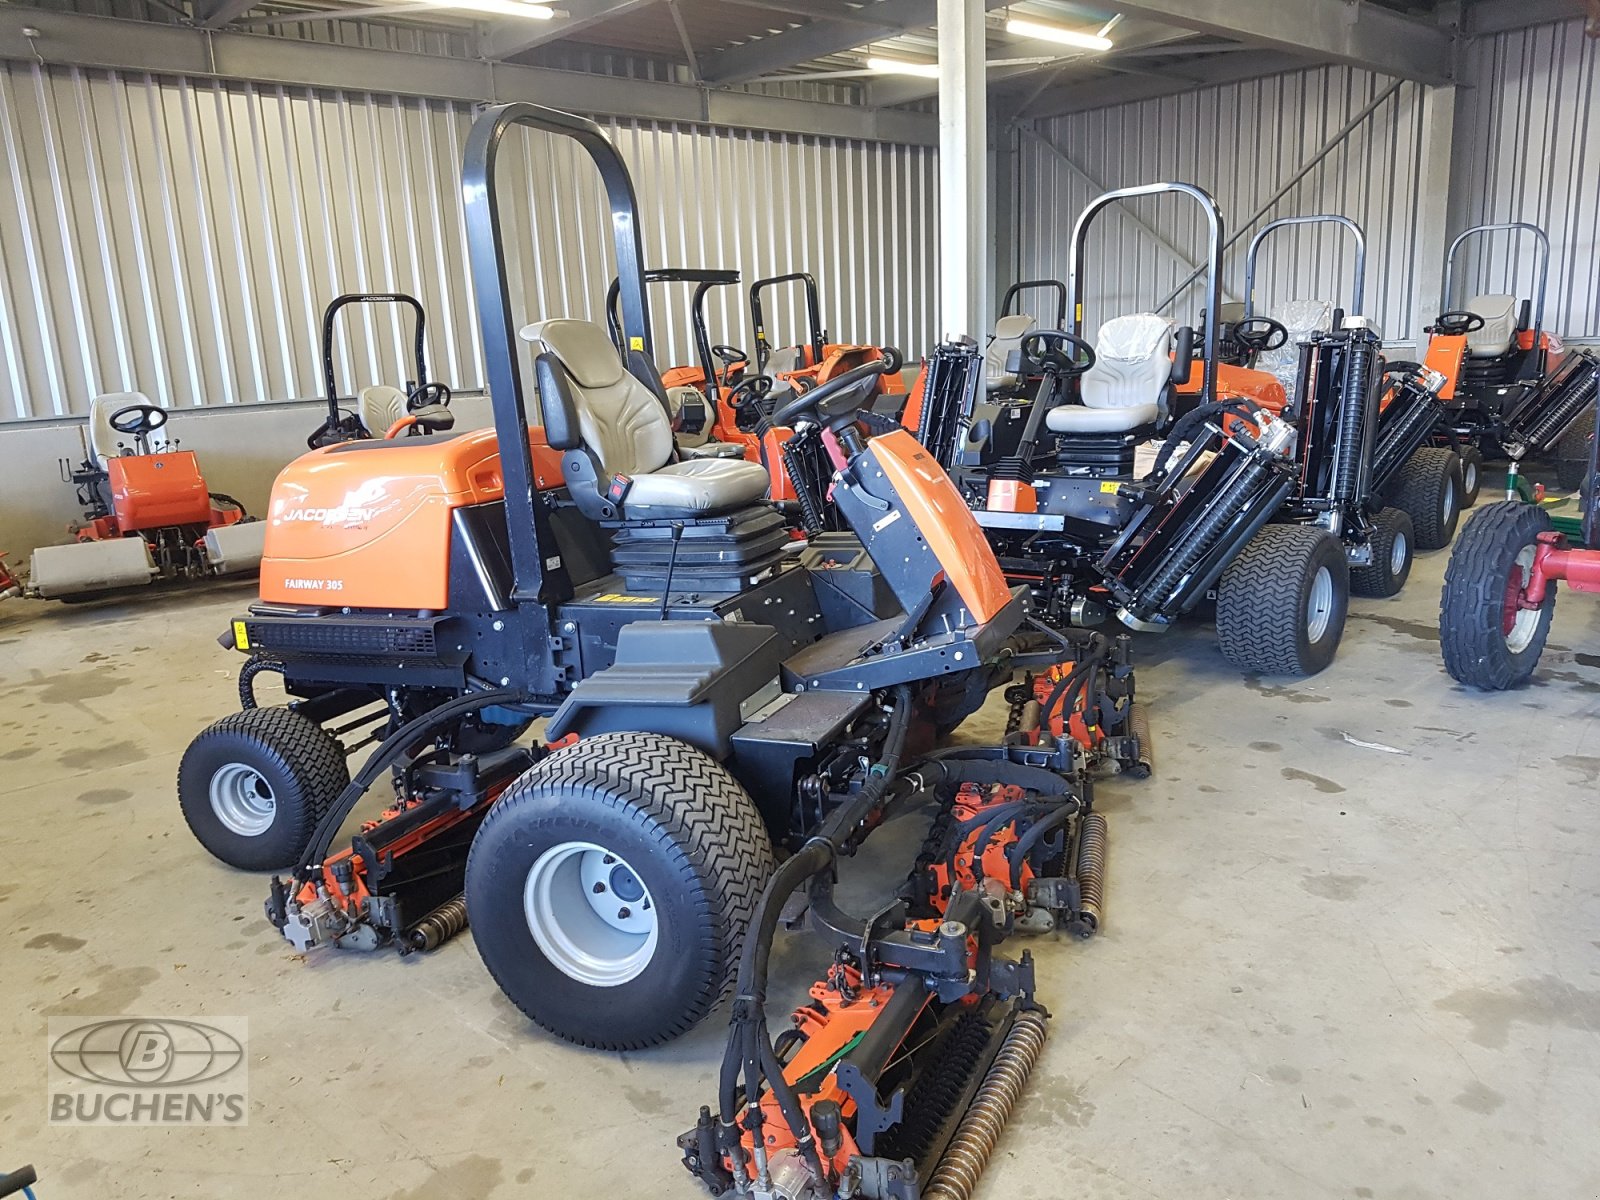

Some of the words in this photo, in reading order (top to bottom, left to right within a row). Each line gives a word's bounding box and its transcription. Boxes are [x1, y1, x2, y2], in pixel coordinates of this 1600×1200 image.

[283, 508, 375, 521] JACOEN
[285, 578, 324, 589] FAIRWAY
[326, 580, 343, 590] 305
